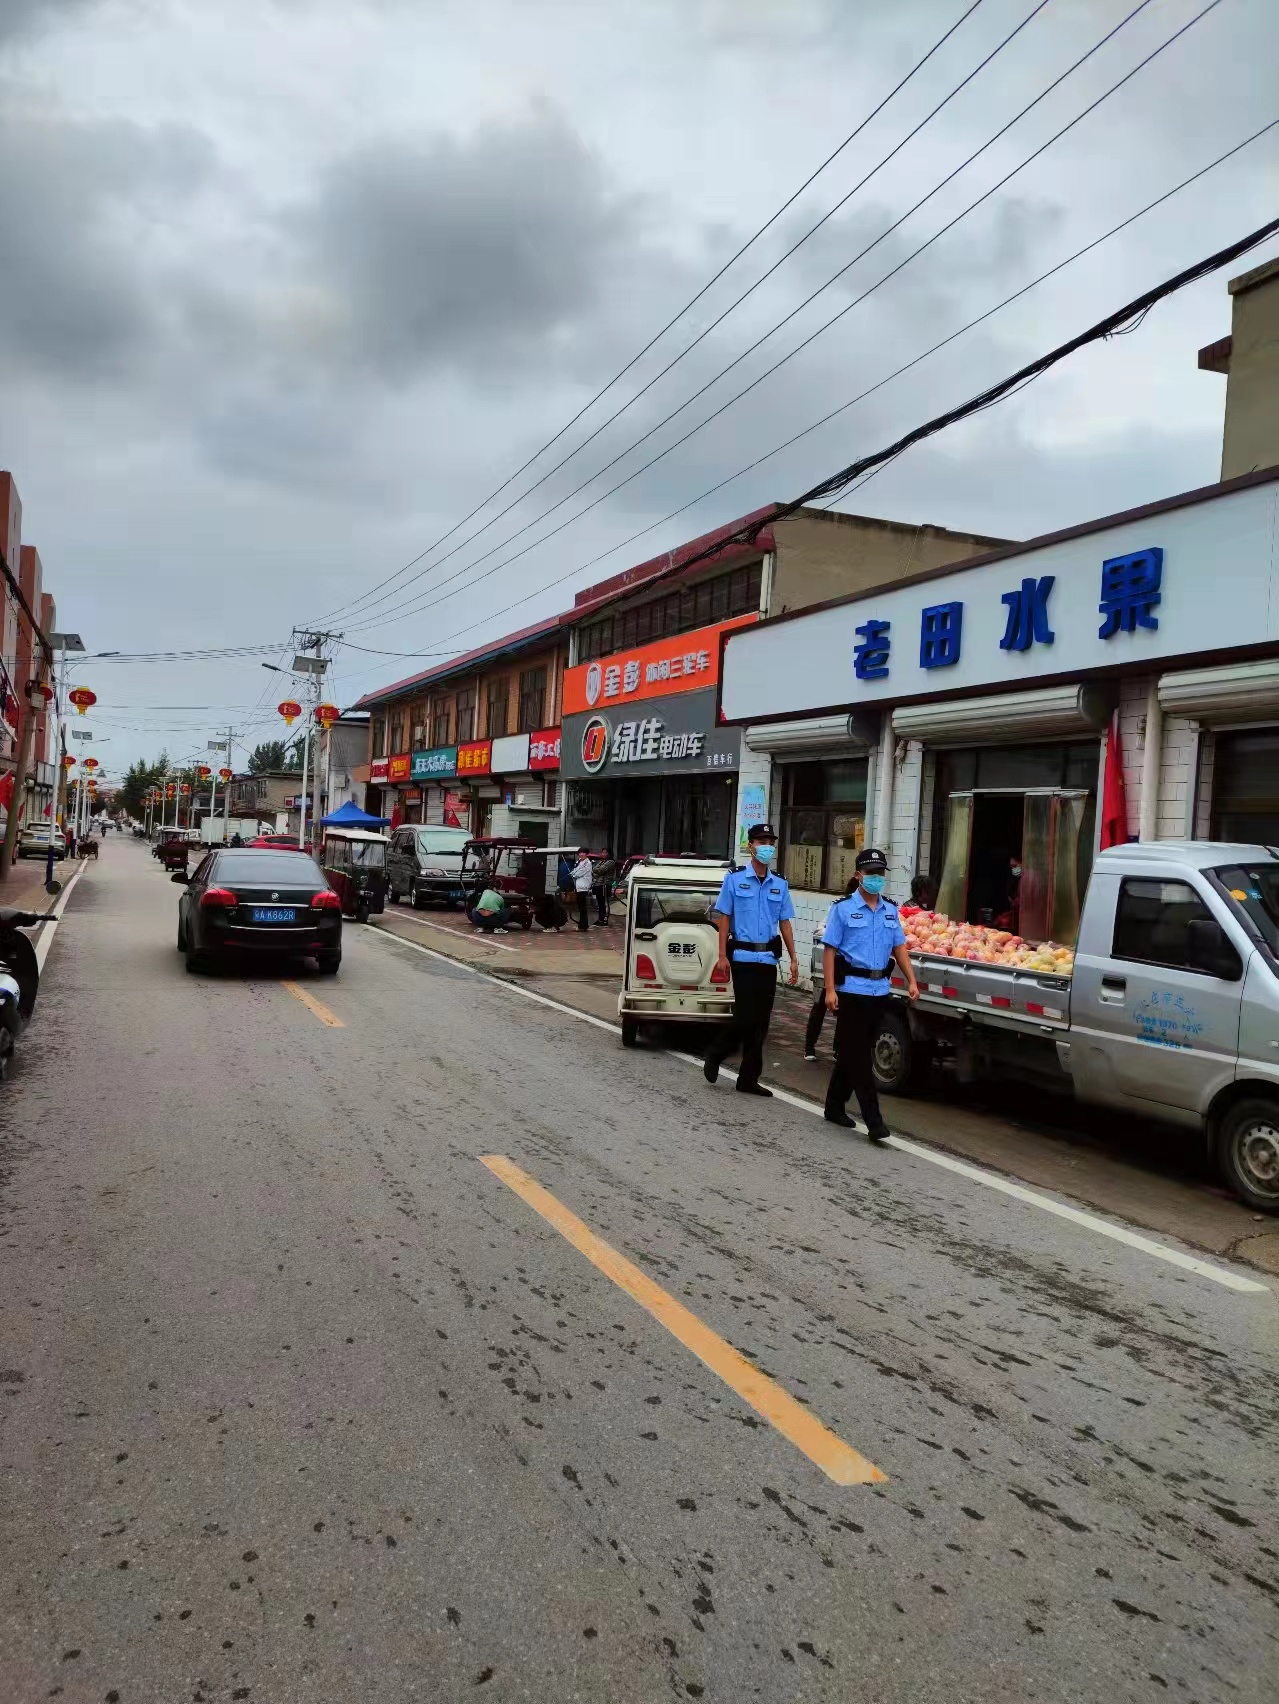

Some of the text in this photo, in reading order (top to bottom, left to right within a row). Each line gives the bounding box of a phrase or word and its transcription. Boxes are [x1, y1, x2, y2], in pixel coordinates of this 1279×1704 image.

[853, 547, 1163, 680] 老田水果
[646, 650, 710, 683] 休闲三轮车
[611, 717, 705, 763] 绿佳 电动车
[667, 942, 697, 954] 金彭
